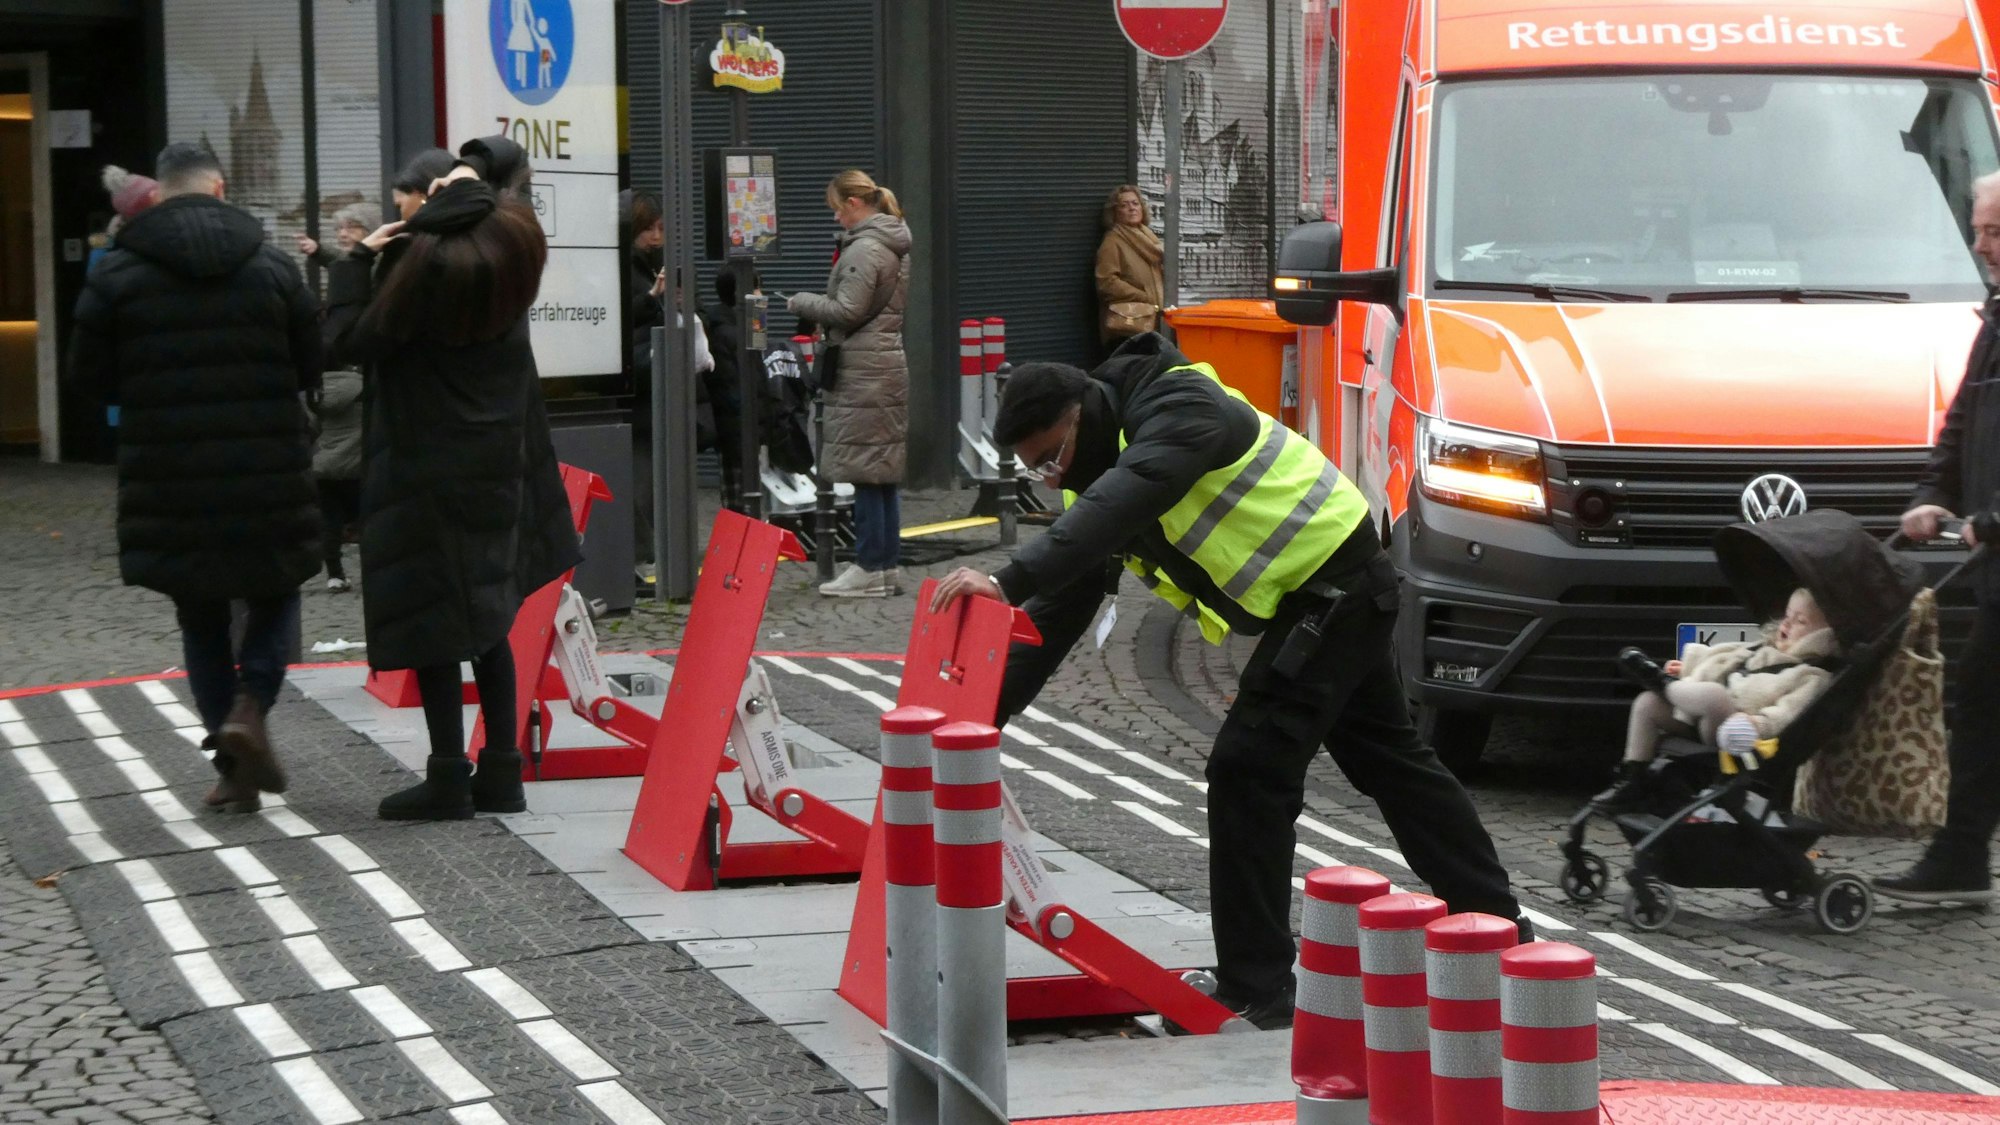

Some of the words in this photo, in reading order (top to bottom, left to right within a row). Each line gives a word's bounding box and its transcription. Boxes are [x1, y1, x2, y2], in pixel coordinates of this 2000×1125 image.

[1507, 15, 1906, 52] Rettungsdienst
[1717, 267, 1777, 277] 01-RTW-02
[529, 302, 607, 326] erfahrzeuge
[760, 730, 781, 761] ARMIS
[771, 760, 788, 781] ONE
